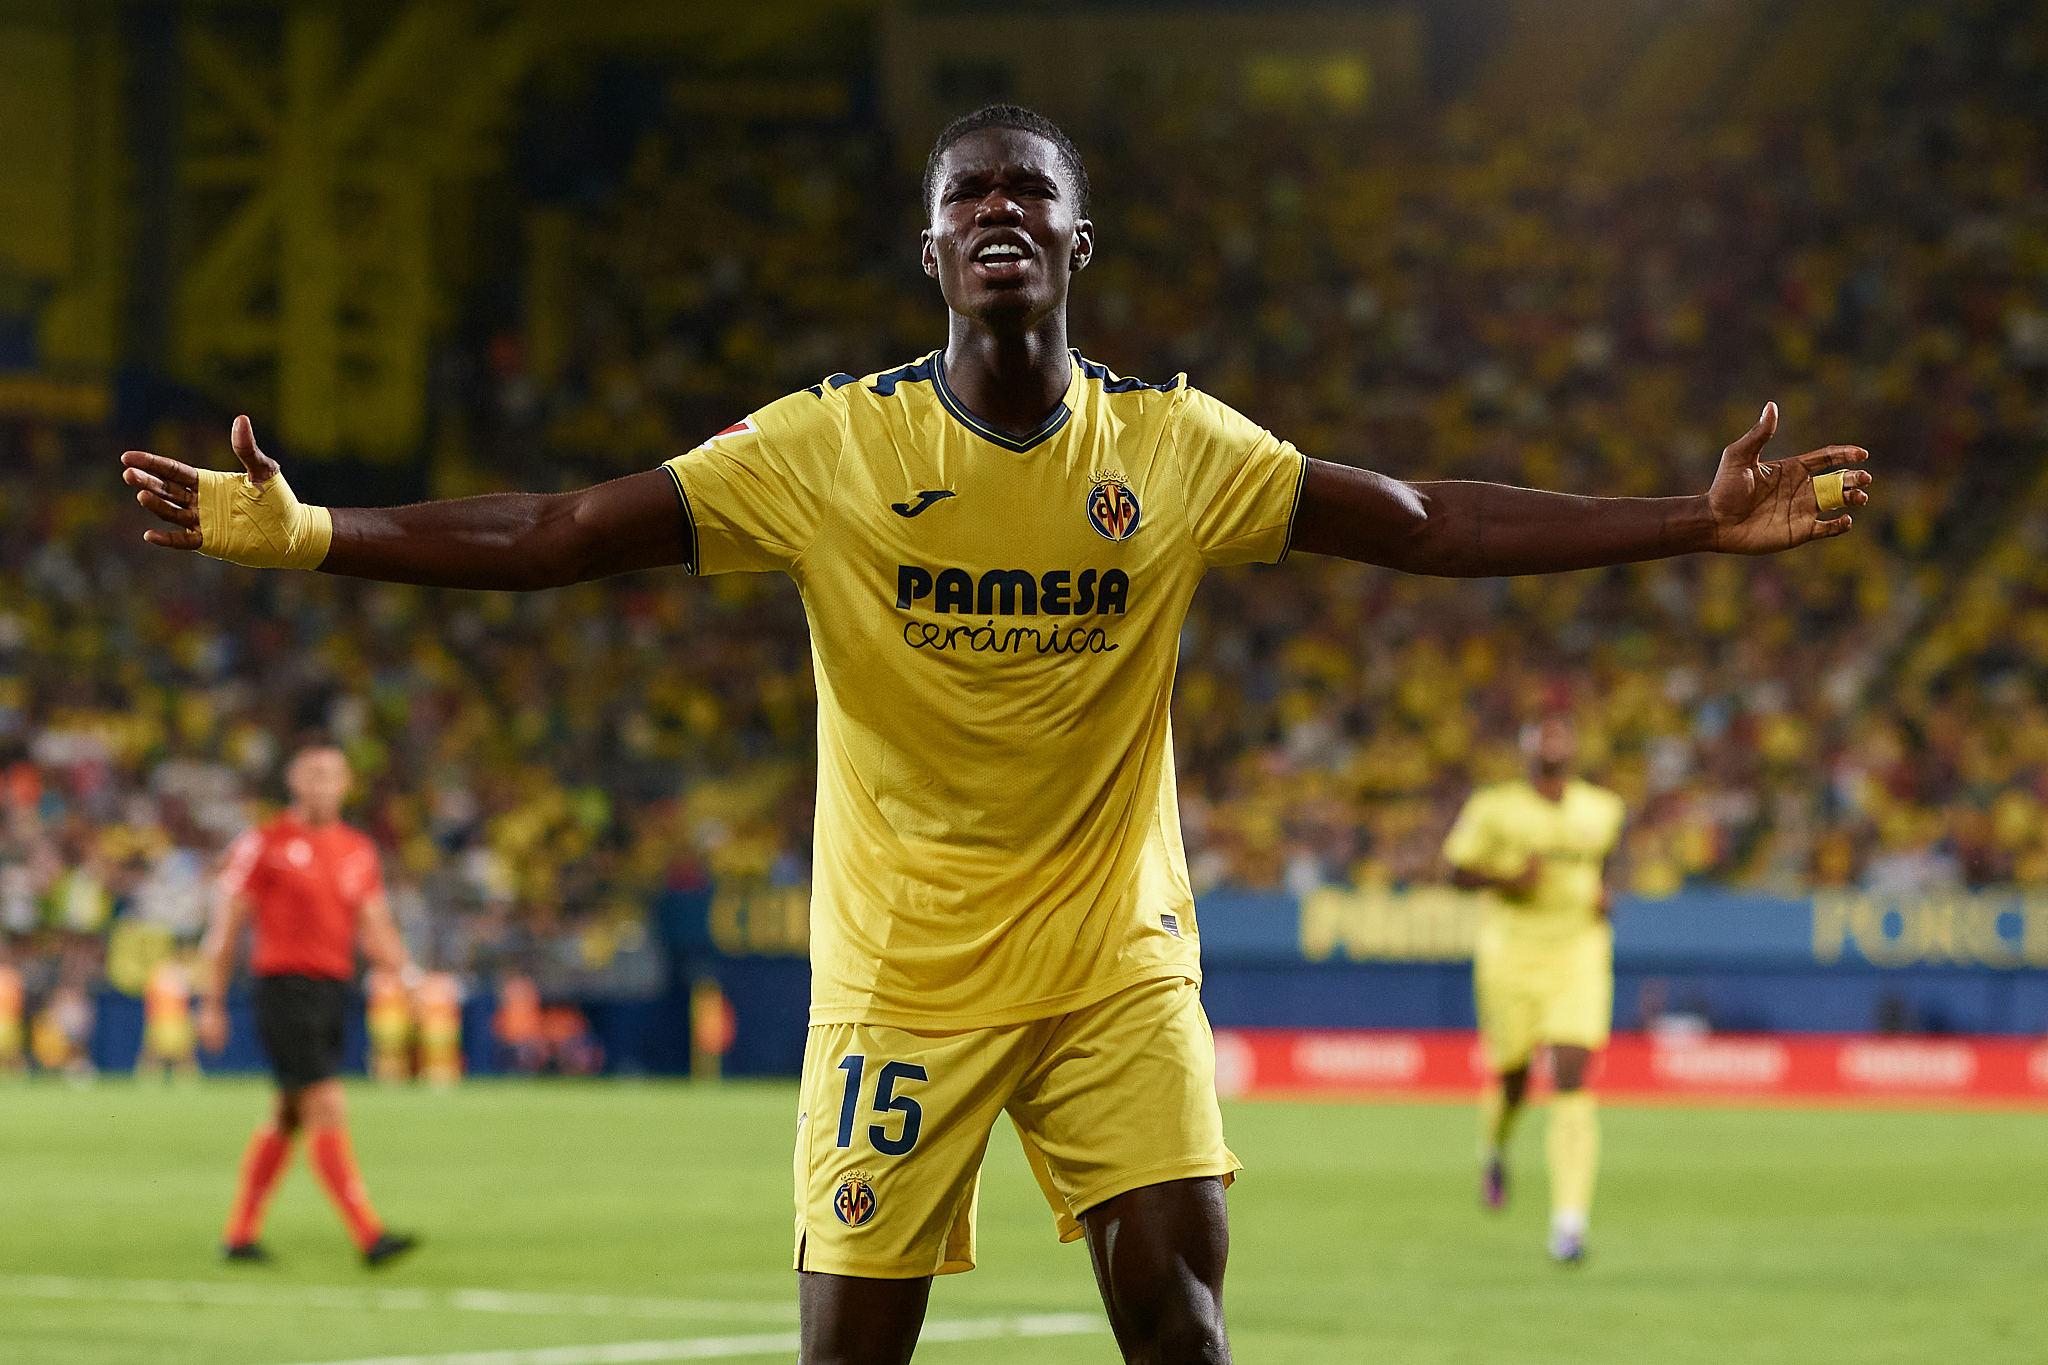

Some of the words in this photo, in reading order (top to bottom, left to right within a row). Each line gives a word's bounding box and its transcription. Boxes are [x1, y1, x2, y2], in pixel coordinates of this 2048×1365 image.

[896, 565, 1130, 616] PAMESA
[903, 619, 1120, 654] cerámica
[836, 1054, 930, 1156] 15
